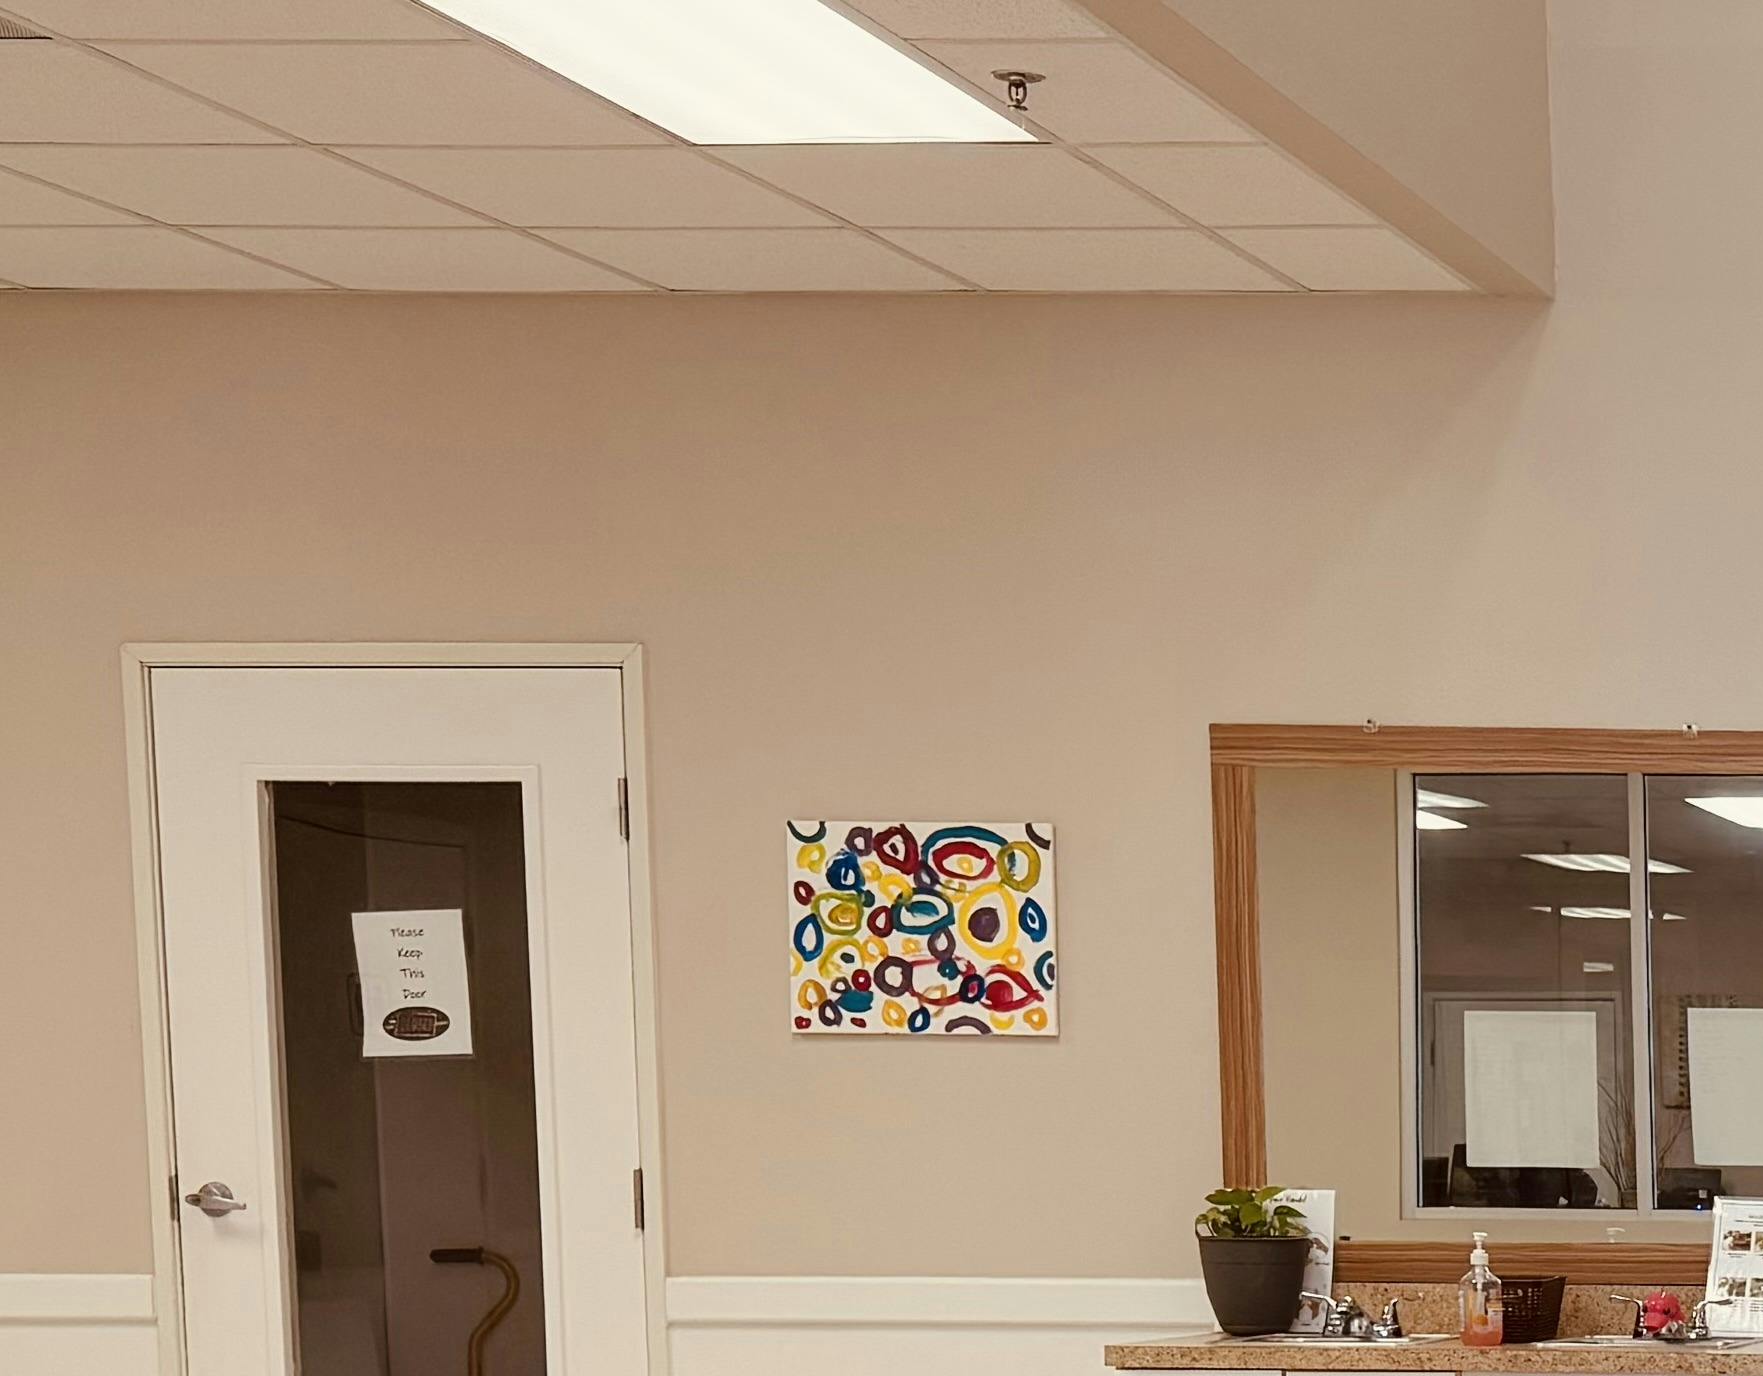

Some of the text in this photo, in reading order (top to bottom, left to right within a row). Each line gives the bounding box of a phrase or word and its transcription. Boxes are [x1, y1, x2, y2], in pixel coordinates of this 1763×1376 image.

[396, 948, 423, 959] Keep
[400, 968, 425, 978] This
[402, 989, 427, 999] Door
